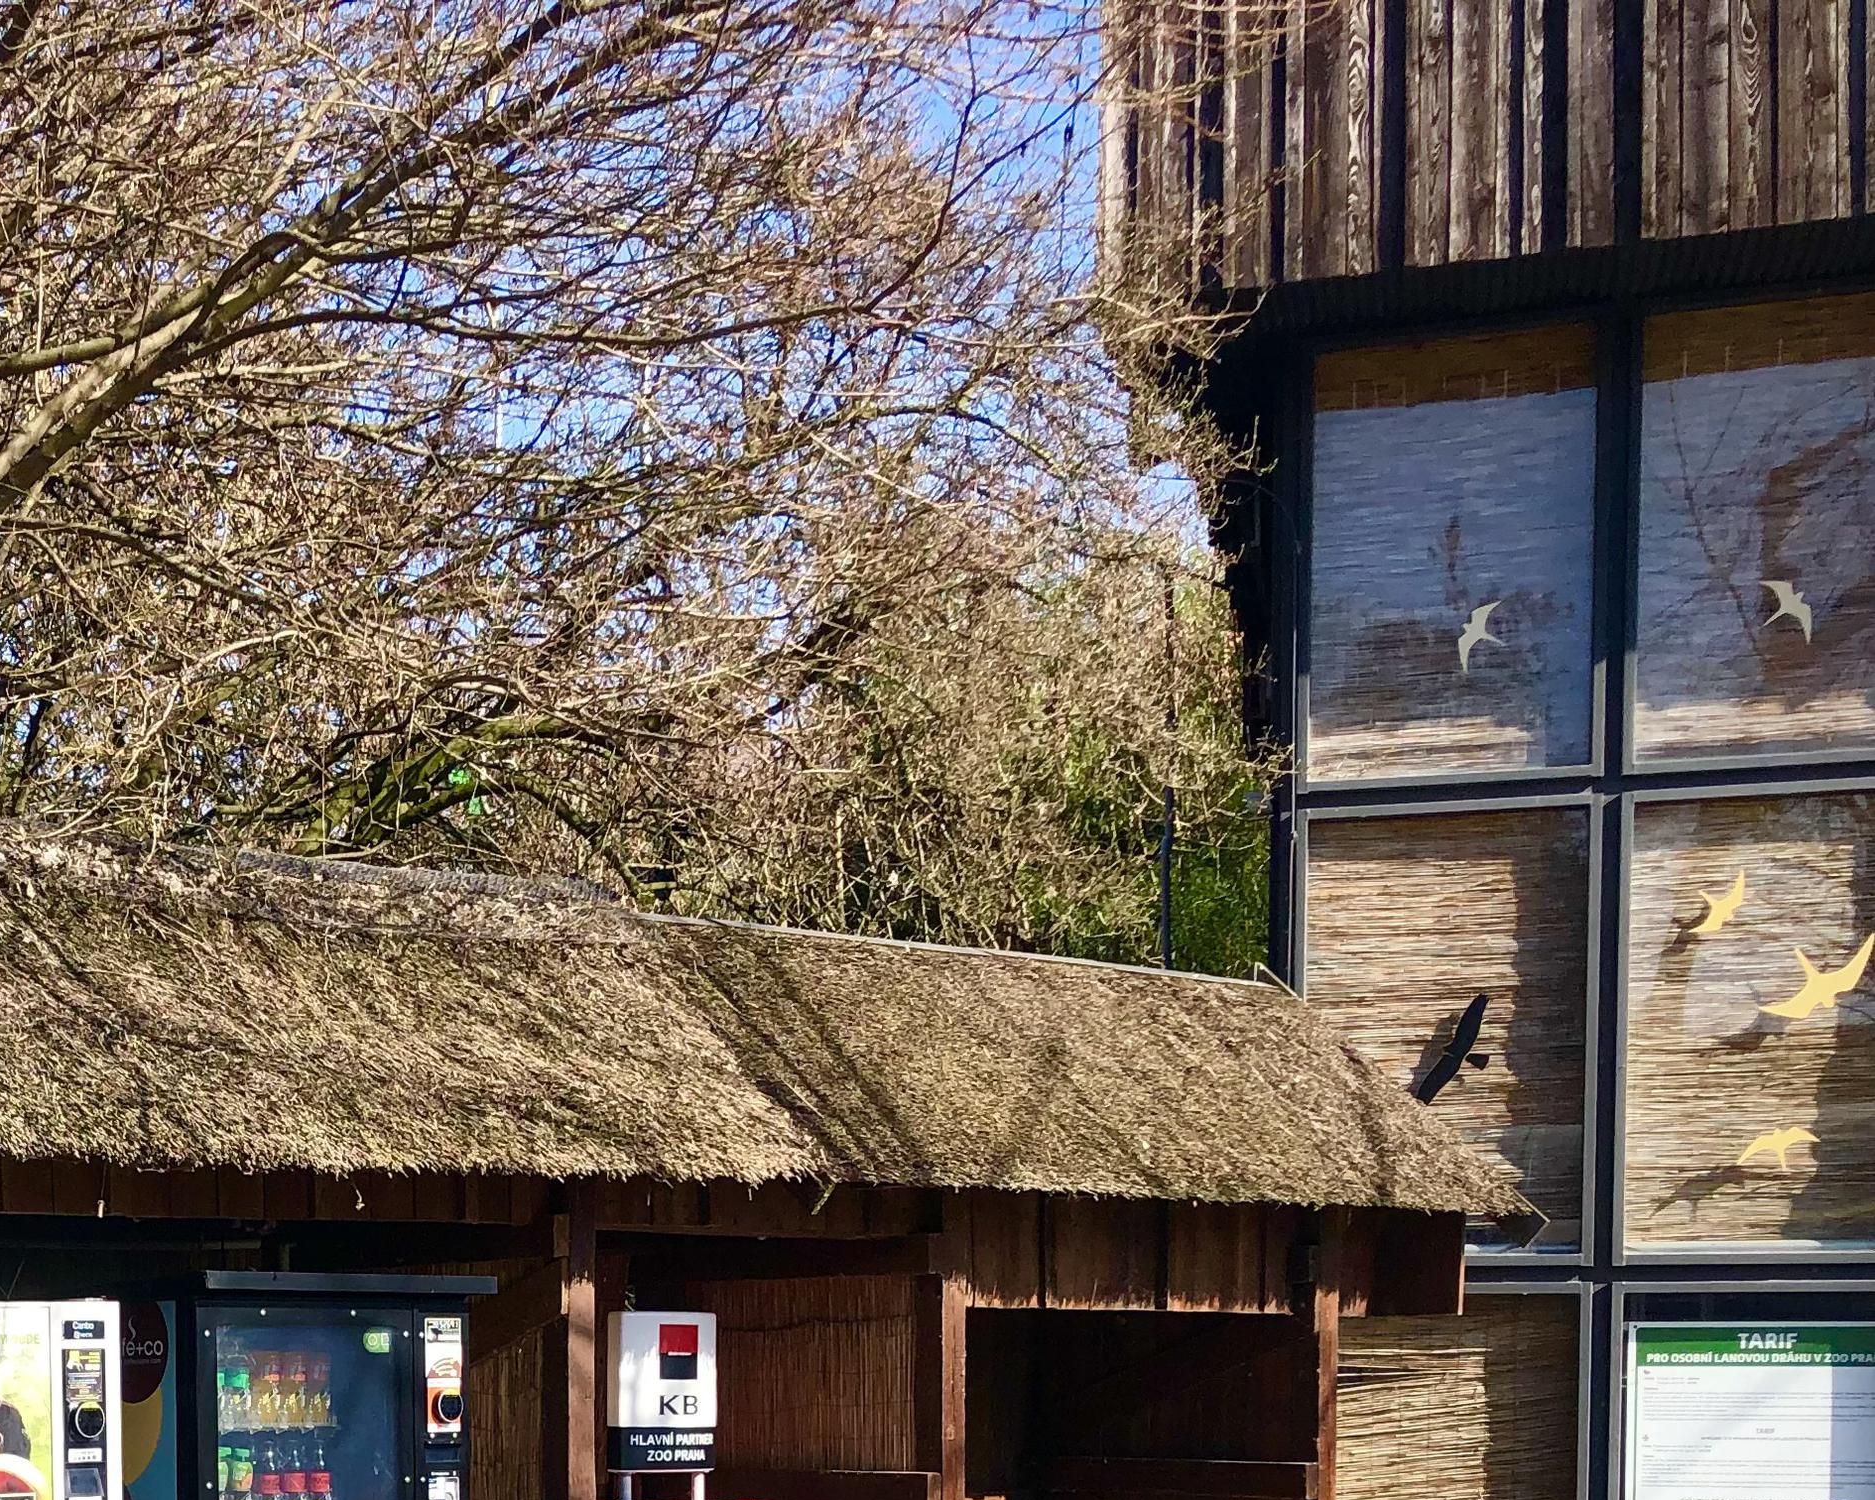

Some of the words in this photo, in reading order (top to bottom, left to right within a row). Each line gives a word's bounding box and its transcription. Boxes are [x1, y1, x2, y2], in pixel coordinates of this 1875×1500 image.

[1737, 1332, 1798, 1349] TARIF
[1645, 1353, 1669, 1363] PRO
[1670, 1351, 1712, 1363] OSOBNÍ
[1713, 1353, 1770, 1363] LANOVOU
[1771, 1351, 1811, 1363] DRÁHU
[1812, 1353, 1822, 1363] V
[1823, 1353, 1849, 1363] ZOO
[659, 1394, 698, 1416] KB
[629, 1431, 674, 1446] HLAVNÍ
[646, 1450, 673, 1462] ZOO
[674, 1449, 706, 1462] PRAHA
